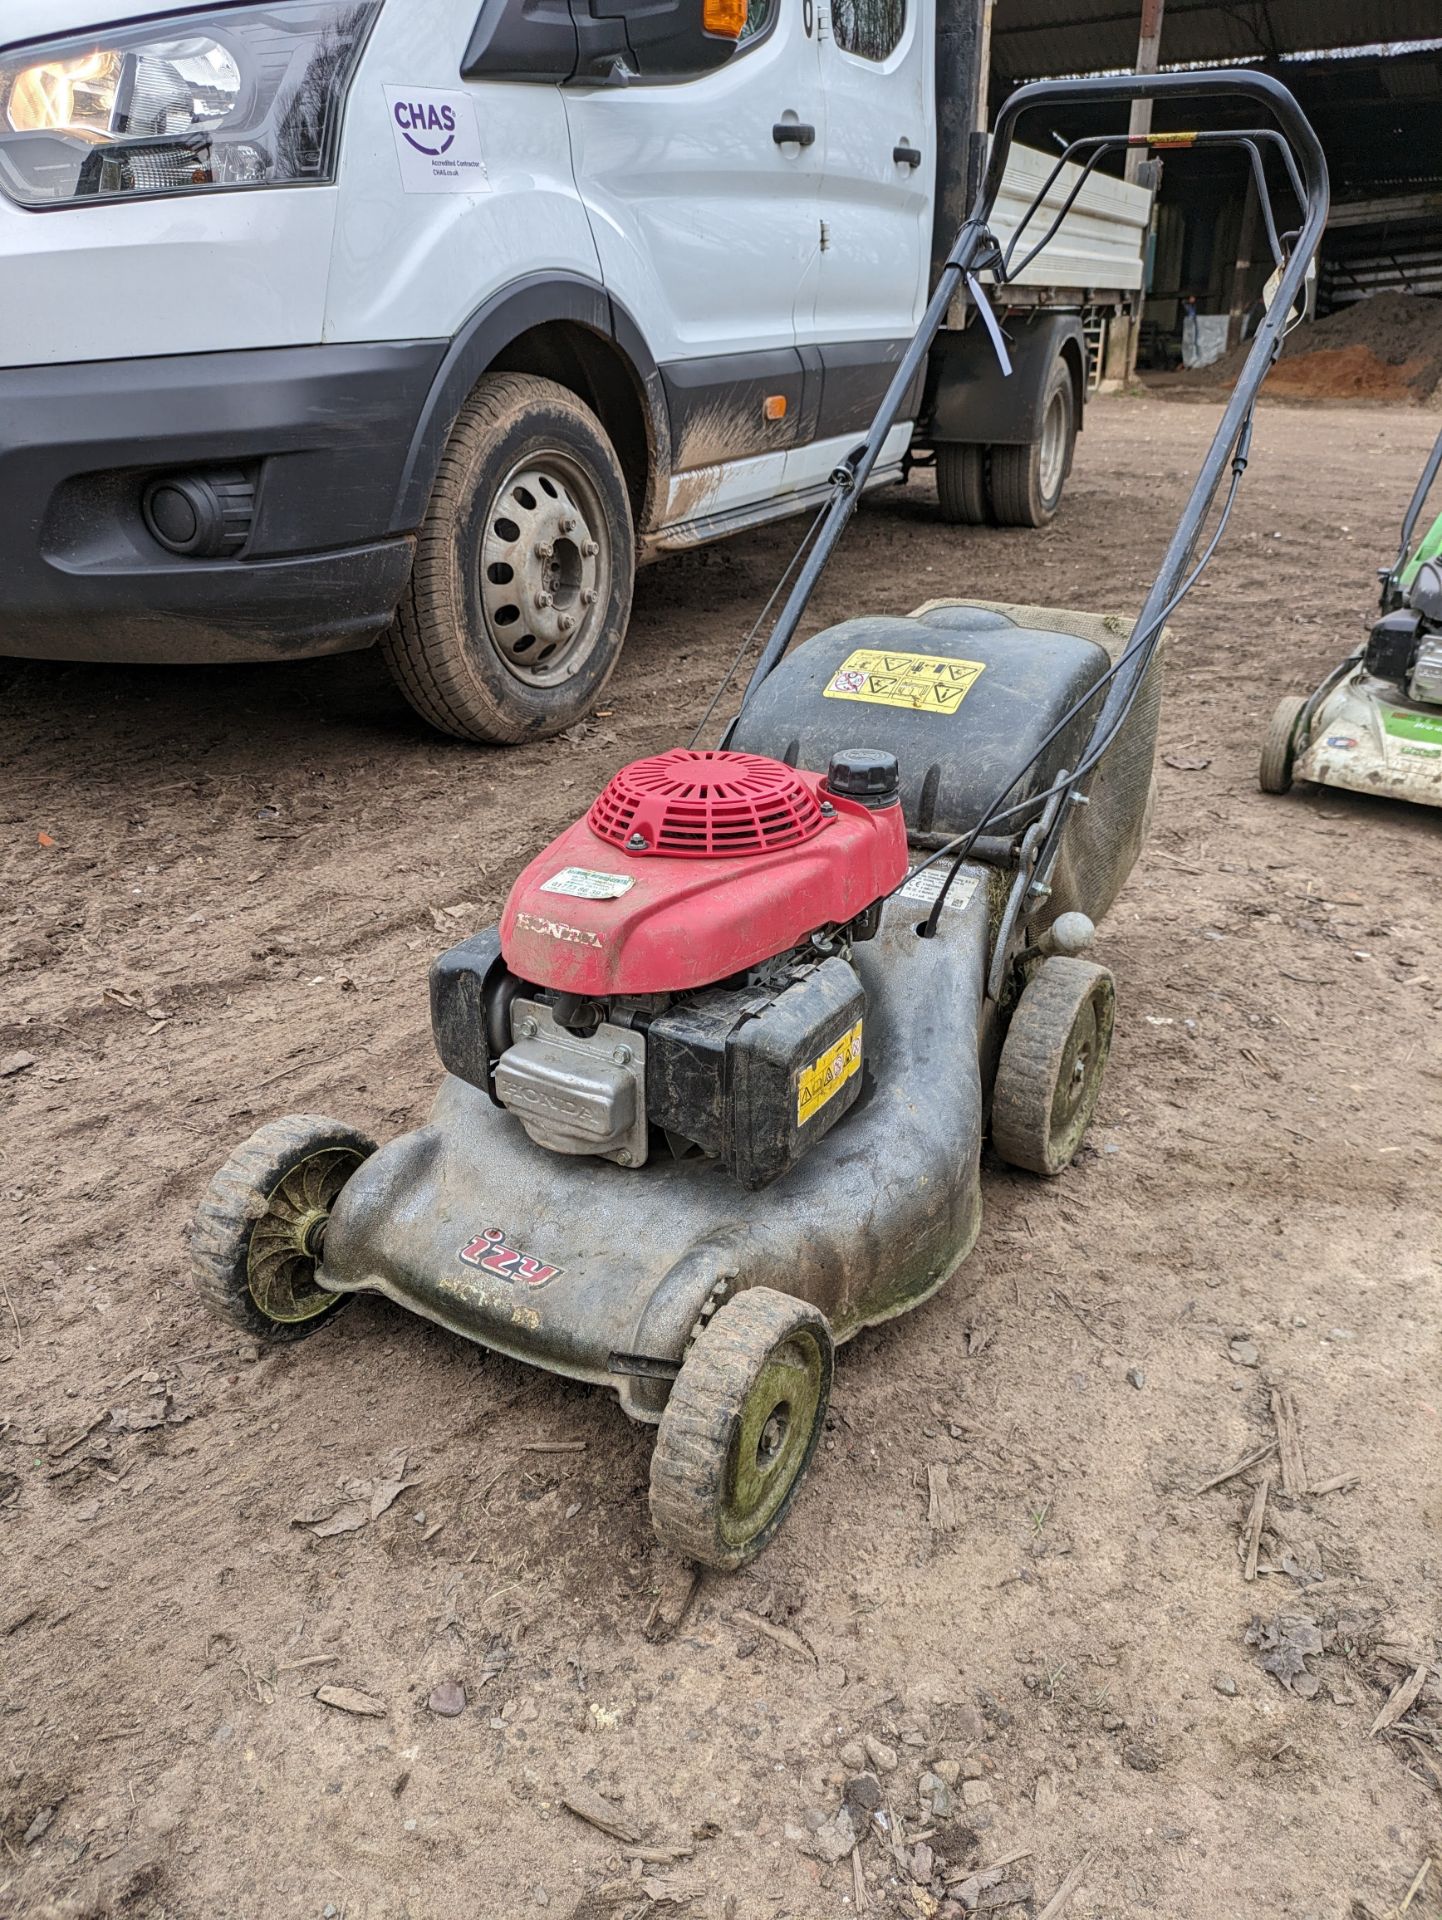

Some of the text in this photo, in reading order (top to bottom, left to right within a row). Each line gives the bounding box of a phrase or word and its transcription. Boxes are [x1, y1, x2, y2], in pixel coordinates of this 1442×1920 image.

[394, 101, 456, 132] CHAS
[431, 159, 480, 168] Accredited Contractor
[432, 168, 459, 176] CHAS.co.uk
[500, 1079, 600, 1126] HONDA
[461, 1228, 564, 1289] izy
